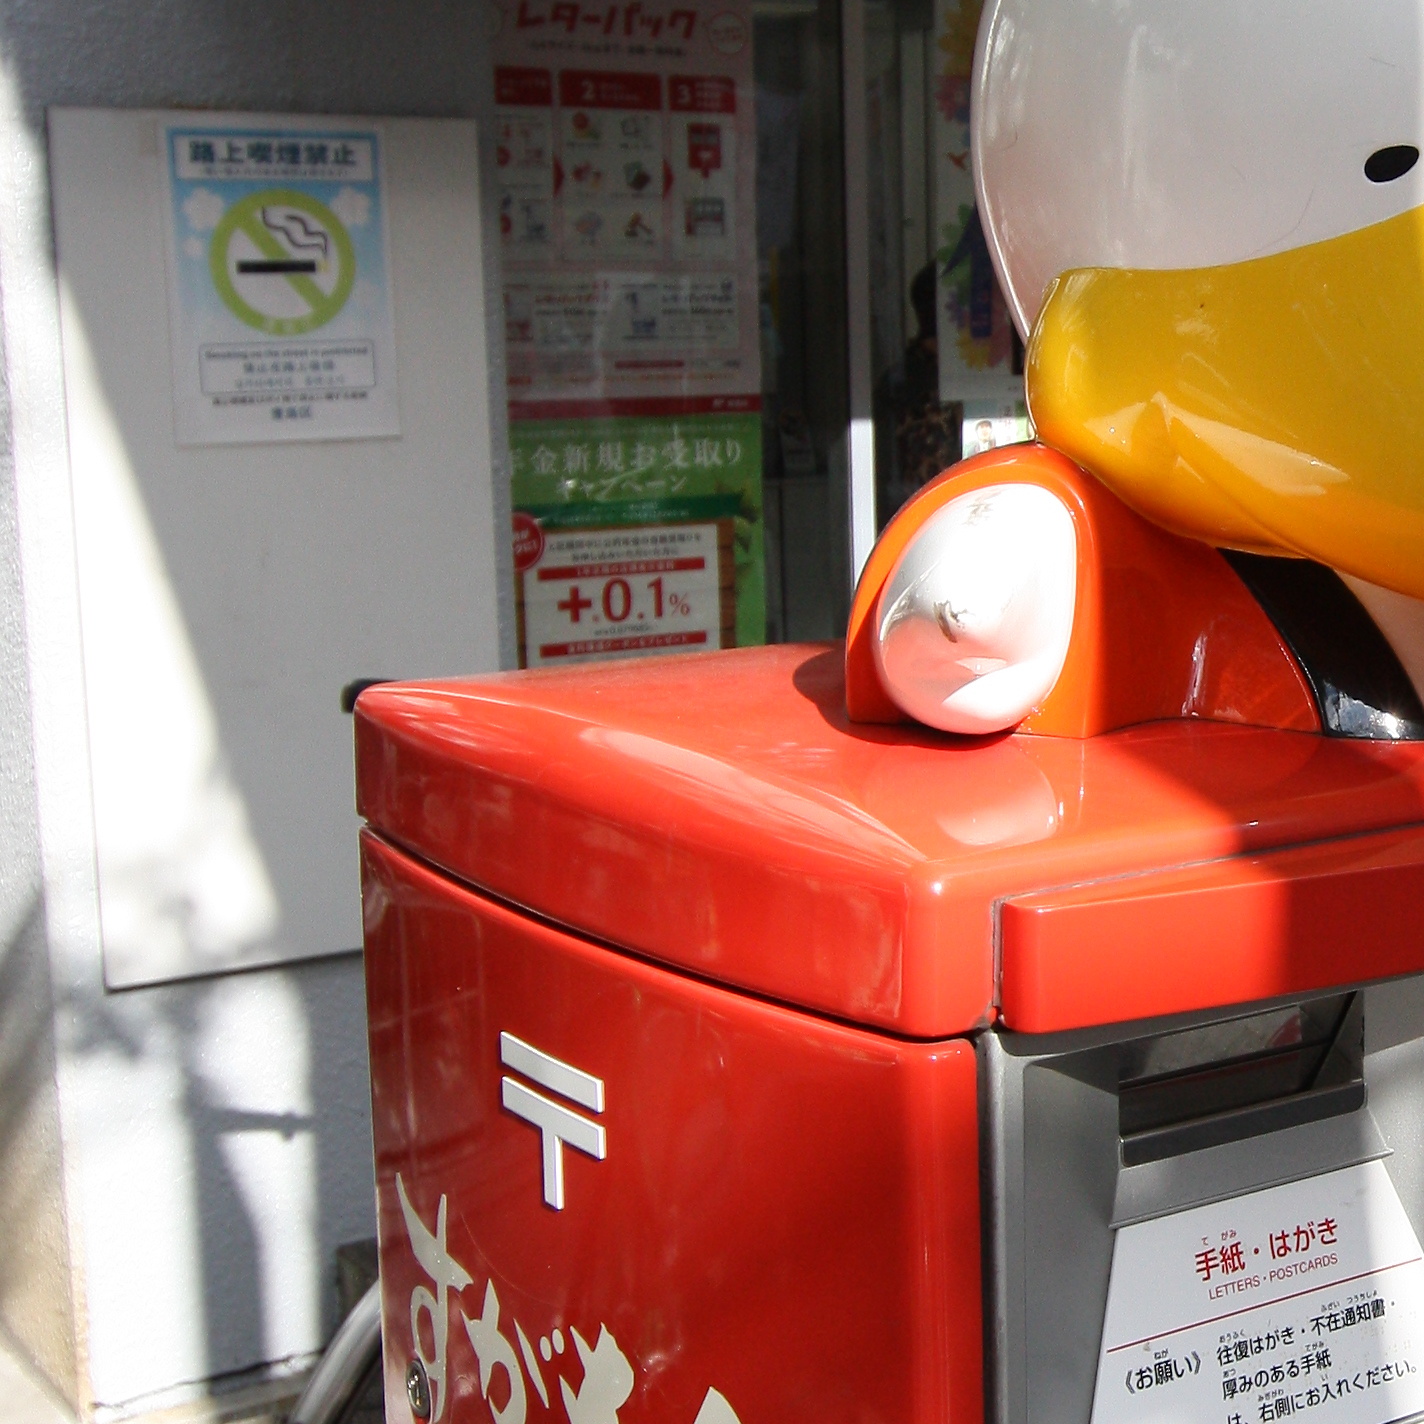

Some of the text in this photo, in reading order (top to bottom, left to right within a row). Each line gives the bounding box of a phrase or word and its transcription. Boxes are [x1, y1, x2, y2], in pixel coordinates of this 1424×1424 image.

[516, 0, 698, 41] レターパック
[1194, 1217, 1339, 1283] 手紙・はがき
[1221, 1347, 1333, 1402] 厚みのある手紙
